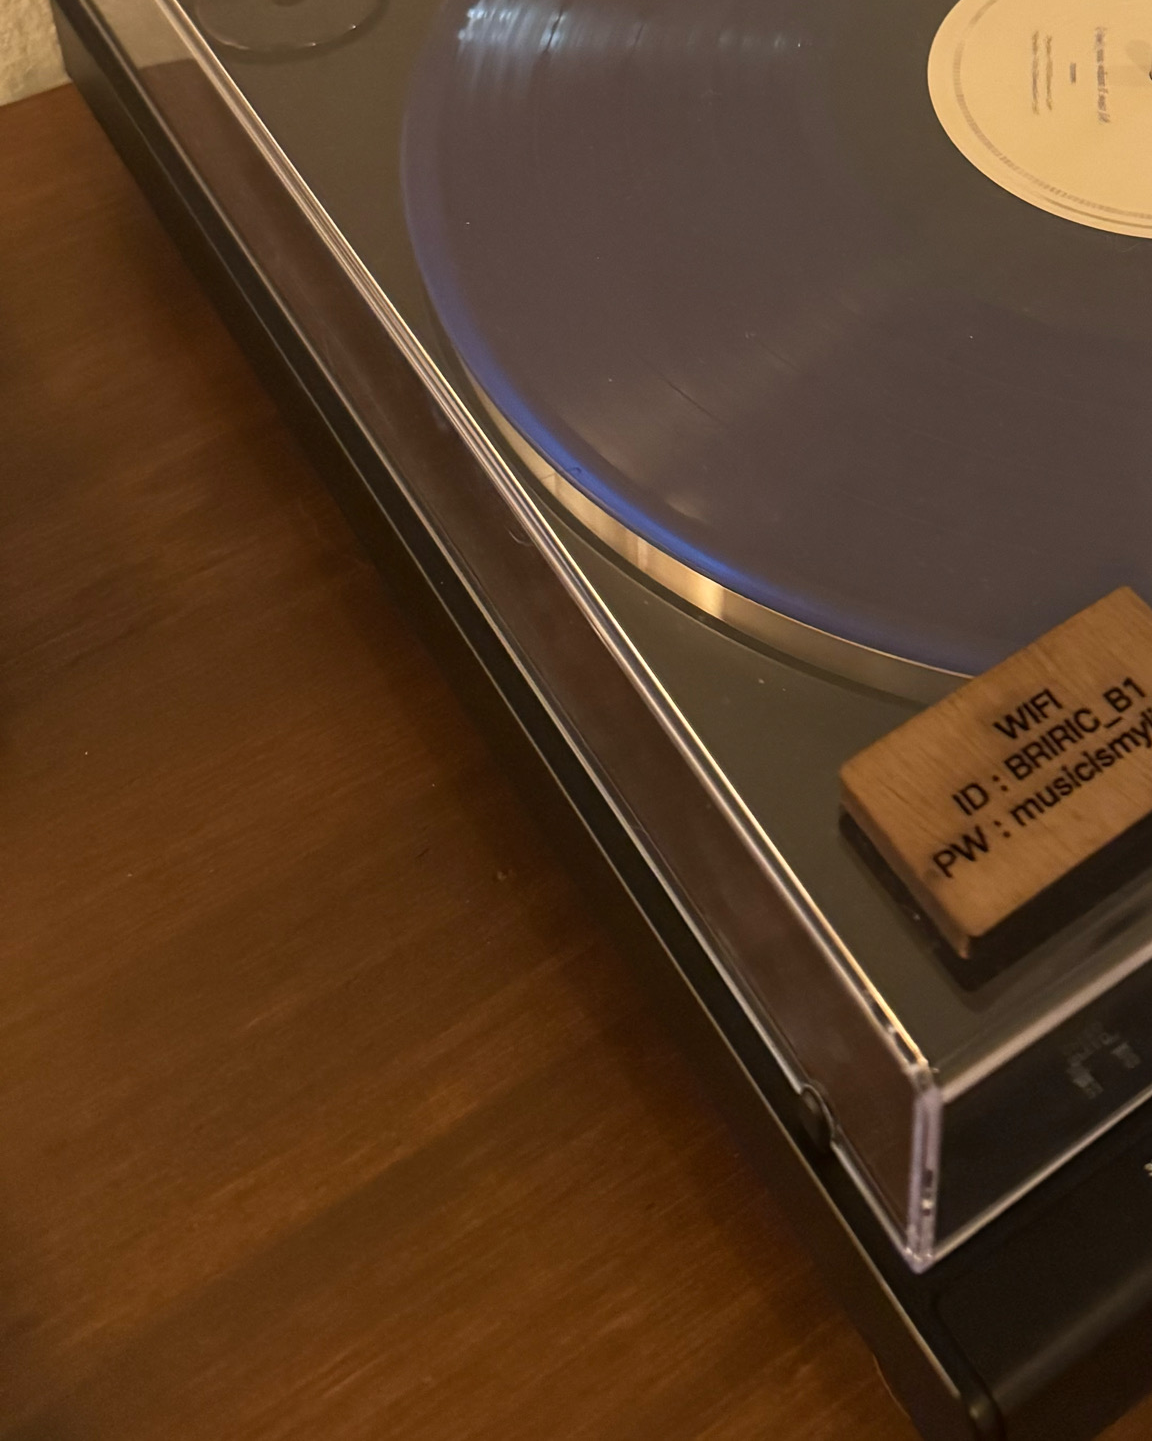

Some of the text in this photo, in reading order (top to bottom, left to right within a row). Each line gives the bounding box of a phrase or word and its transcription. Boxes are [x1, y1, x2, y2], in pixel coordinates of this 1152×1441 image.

[993, 688, 1064, 740] WIFI
[952, 782, 990, 816] ID
[1004, 677, 1147, 780] BRIRIC_B1
[933, 825, 990, 878] PW
